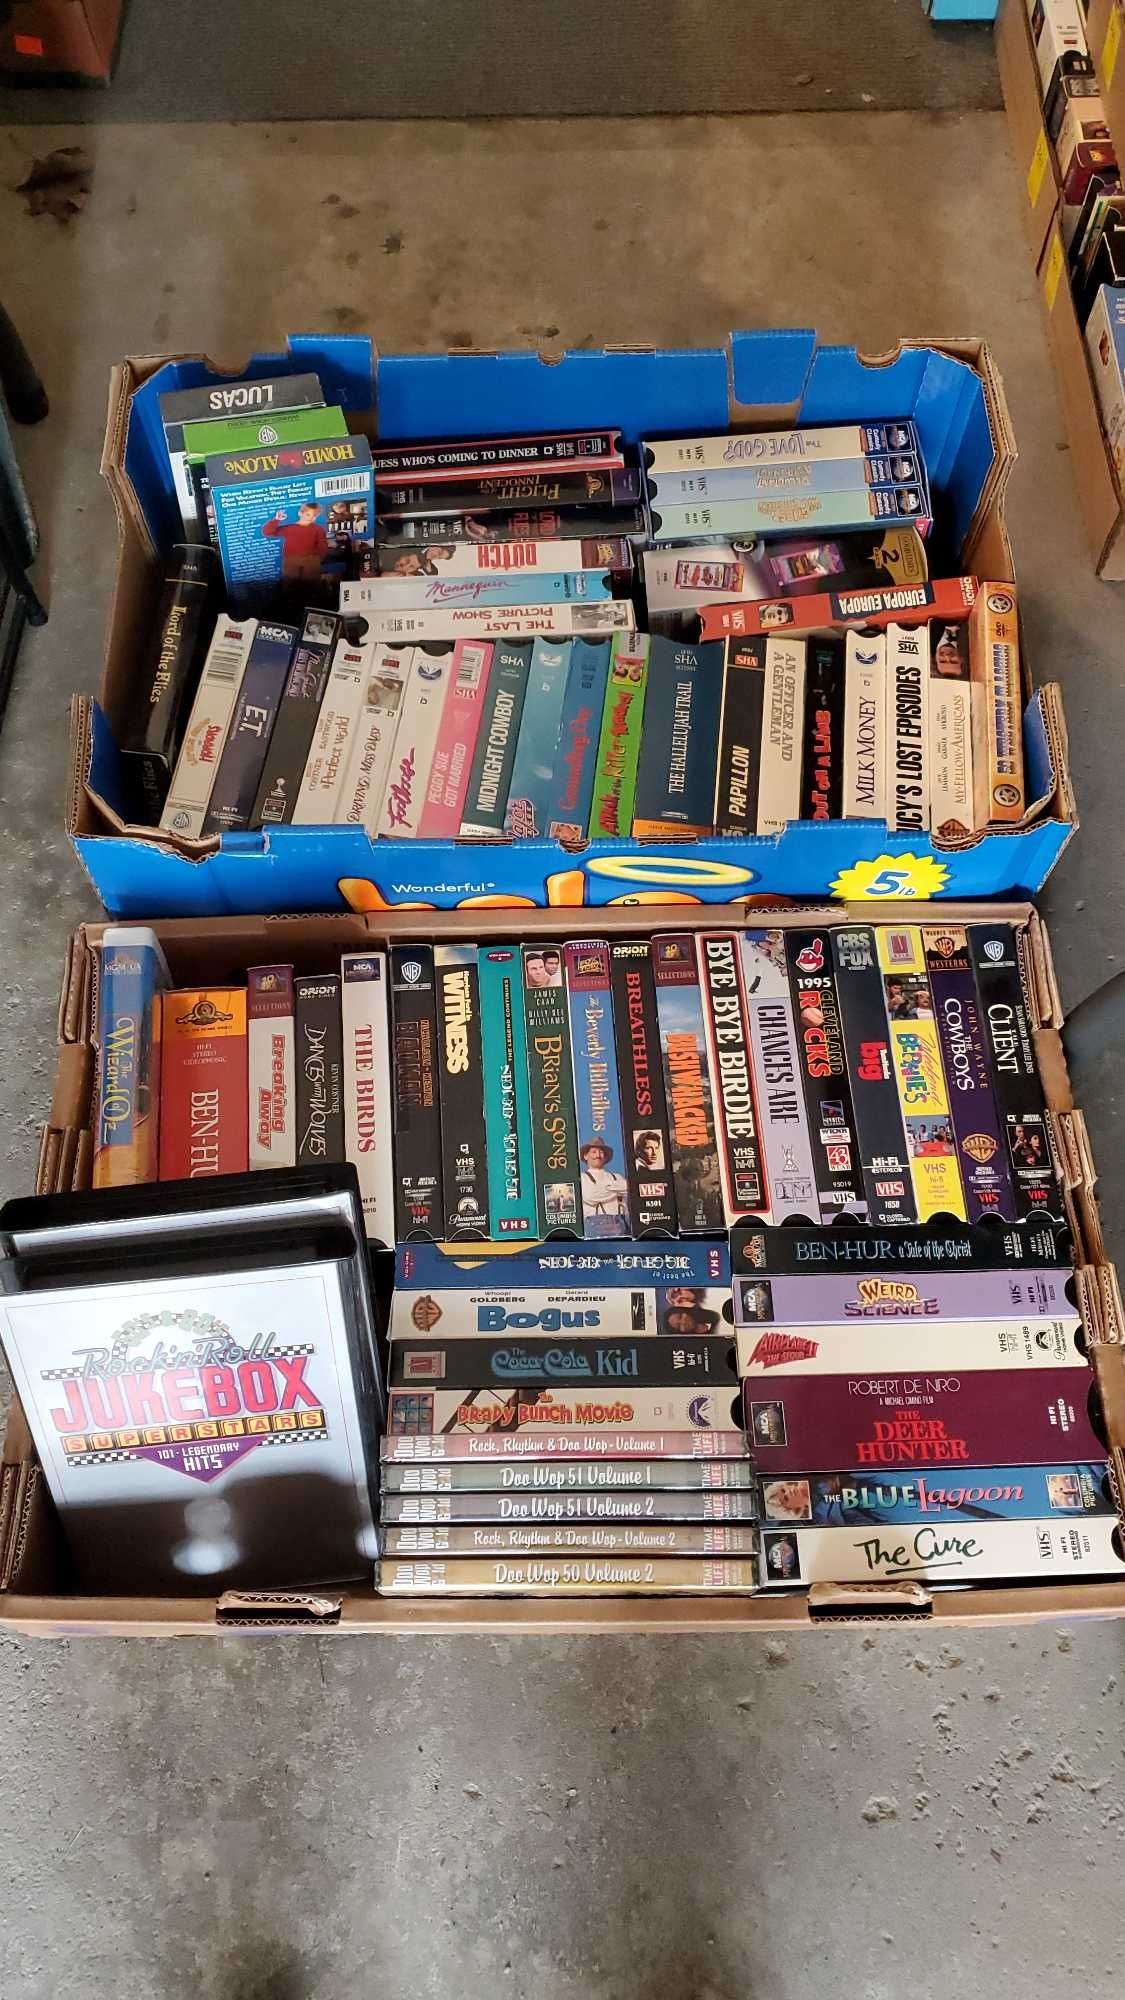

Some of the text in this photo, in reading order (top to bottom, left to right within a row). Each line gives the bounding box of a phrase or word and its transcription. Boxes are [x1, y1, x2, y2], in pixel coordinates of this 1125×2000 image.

[210, 385, 273, 410] LUCAS
[374, 447, 538, 468] UESS WHO'S COMING TO DINNER
[478, 543, 536, 570] DUTCH
[838, 589, 926, 614] EUROPA EUROPA
[452, 608, 552, 620] PICTURE SHOW
[484, 619, 554, 632] THE LAST
[257, 626, 289, 638] MCA
[150, 606, 188, 703] Lord of the Flies
[500, 656, 525, 666] VHS
[674, 655, 698, 666] VHS
[770, 652, 783, 746] A GENTLEMAN
[781, 652, 796, 762] AN OFFICER AND
[668, 682, 692, 794] THE HALLELUJAH TRAIL
[895, 666, 922, 832] UCY'S LOST EPISODES
[477, 690, 514, 812] MIDNIGHT COWBOY
[856, 696, 876, 805] MILK MONEY
[346, 776, 370, 823] DRIVING
[360, 753, 376, 772] MISS
[428, 751, 449, 804] PEGGY SUE
[728, 745, 750, 816] PAPILLON
[444, 786, 457, 808] GOT
[392, 882, 485, 893] Wonderful
[866, 871, 909, 894] 5
[613, 946, 648, 954] ORION
[836, 934, 870, 950] CBS
[984, 940, 1004, 961] WB
[838, 950, 874, 967] FOX
[928, 958, 968, 969] WESTERNS
[401, 961, 422, 983] WB
[798, 978, 832, 989] 1995
[300, 985, 338, 996] ORION
[443, 971, 468, 1074] WITNESS
[530, 1016, 565, 1026] WILLIAMS
[626, 972, 651, 1116] BREATHLESS
[706, 940, 754, 1138] BYE BYE BIRDIE
[820, 990, 844, 1076] CLEVELAND
[944, 998, 975, 1090] COWBOYS
[965, 1035, 974, 1052] THE
[986, 1004, 1020, 1074] CLIENT
[304, 1024, 327, 1082] DANCES
[965, 1000, 988, 1090] JOHN WAYNE
[757, 1005, 800, 1124] CHANCES ARE
[858, 1042, 886, 1080] big
[896, 1033, 930, 1104] BERNIE'S
[272, 1034, 286, 1134] Breaking
[332, 1063, 340, 1114] KEVIN COSTNER
[354, 1024, 376, 1153] THE BIRDS
[666, 1033, 708, 1148] BUSHWHACKED
[258, 1088, 272, 1150] Away
[299, 1096, 331, 1156] WOLVES
[190, 1088, 220, 1178] BEN-HU
[456, 1158, 475, 1166] VHS
[734, 1147, 755, 1156] VHS
[924, 1164, 946, 1174] VHS
[449, 1214, 486, 1225] Paramount
[500, 1220, 528, 1229] VHS
[710, 1250, 720, 1278] VHS
[860, 1280, 917, 1300] WEIRD
[844, 1298, 940, 1316] SCIENCE
[478, 1306, 601, 1332] Bogus
[673, 1350, 686, 1369] VHS
[52, 1356, 321, 1433] JUKEBOX
[848, 1378, 961, 1394] ROBERT DE NIRO
[760, 1412, 770, 1435] MCA
[896, 1410, 920, 1419] THE
[1058, 1398, 1069, 1432] STEREO
[69, 1414, 320, 1450] SUPERSTARS
[873, 1420, 948, 1440] DEER
[157, 1442, 240, 1460] 101 LEGENDARY
[469, 1437, 664, 1454] Rock, Rhythm & Doo Wop Volume 1
[703, 1432, 713, 1455] LIFE
[856, 1439, 970, 1462] HUNTER
[184, 1456, 222, 1472] HITS
[712, 1464, 722, 1486] LIFE
[500, 1466, 651, 1489] Doo Wop 51 Volume 1
[824, 1478, 1024, 1512] THE BLUE Lagoon
[499, 1496, 654, 1520] Doo Wop 51 Volume 2
[474, 1530, 676, 1548] Rock, Rhythm & Doo Wop Volume 2
[853, 1528, 982, 1570] The Cure
[1040, 1531, 1052, 1559] VHS
[494, 1563, 654, 1586] Doo Wop 50 Volume 2
